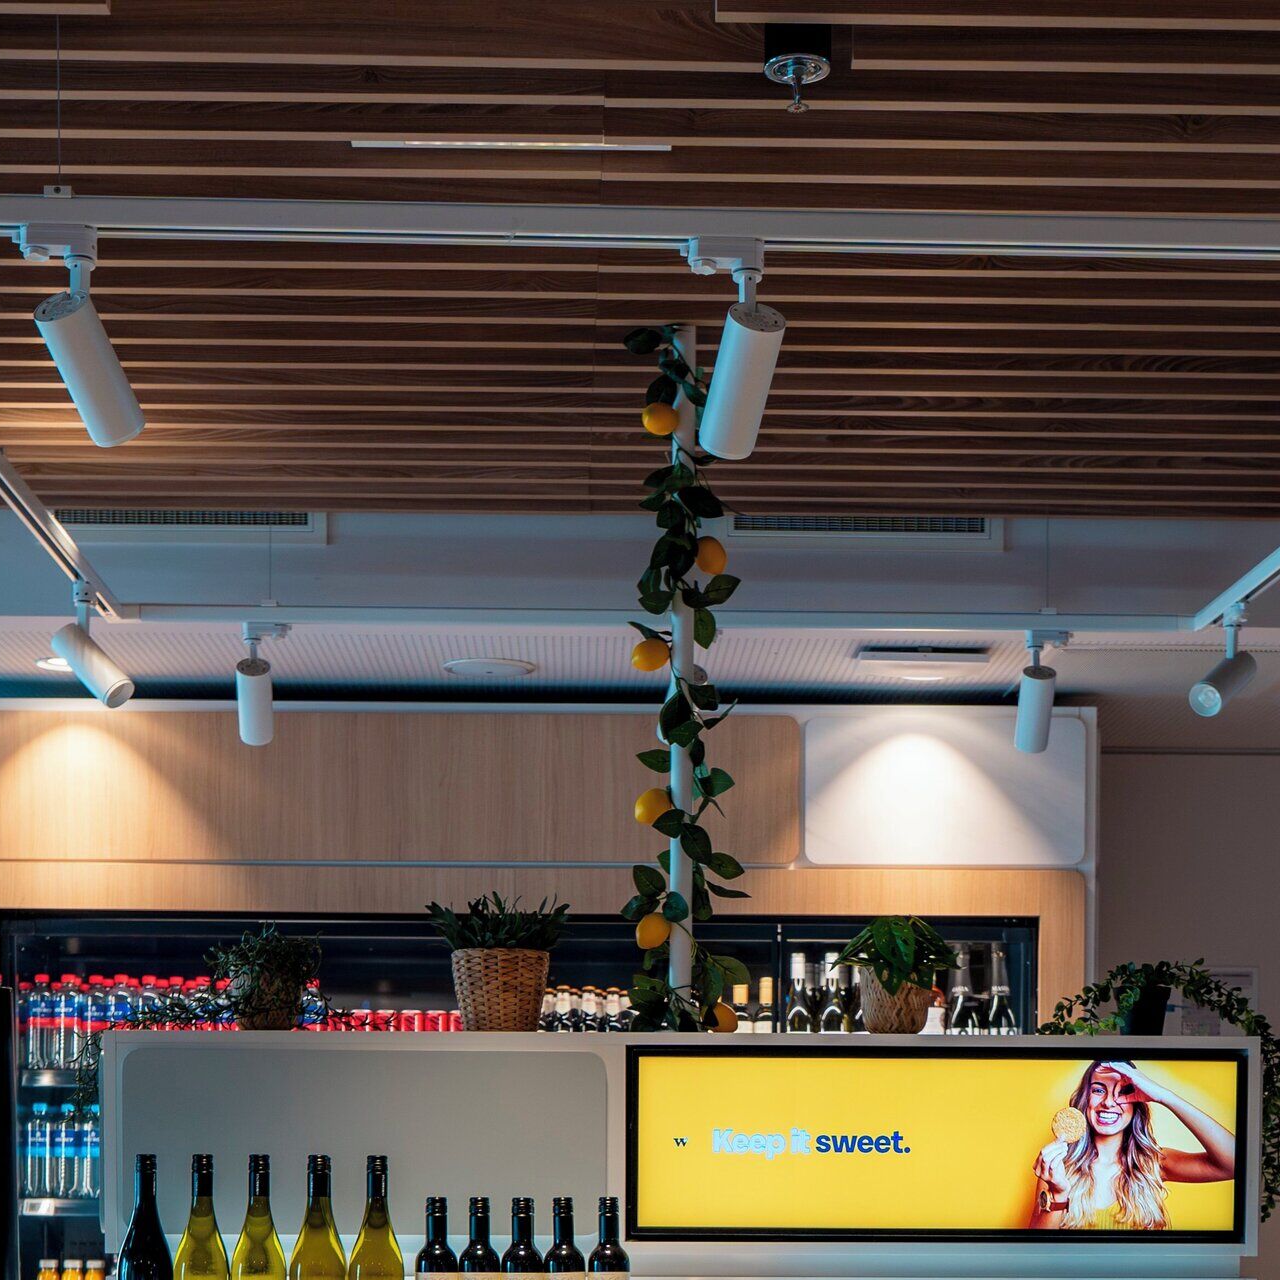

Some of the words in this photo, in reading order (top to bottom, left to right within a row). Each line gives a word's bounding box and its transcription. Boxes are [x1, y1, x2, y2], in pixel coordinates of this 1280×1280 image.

[713, 1128, 786, 1160] Keep
[790, 1127, 811, 1154] it
[815, 1130, 911, 1154] sweet.
